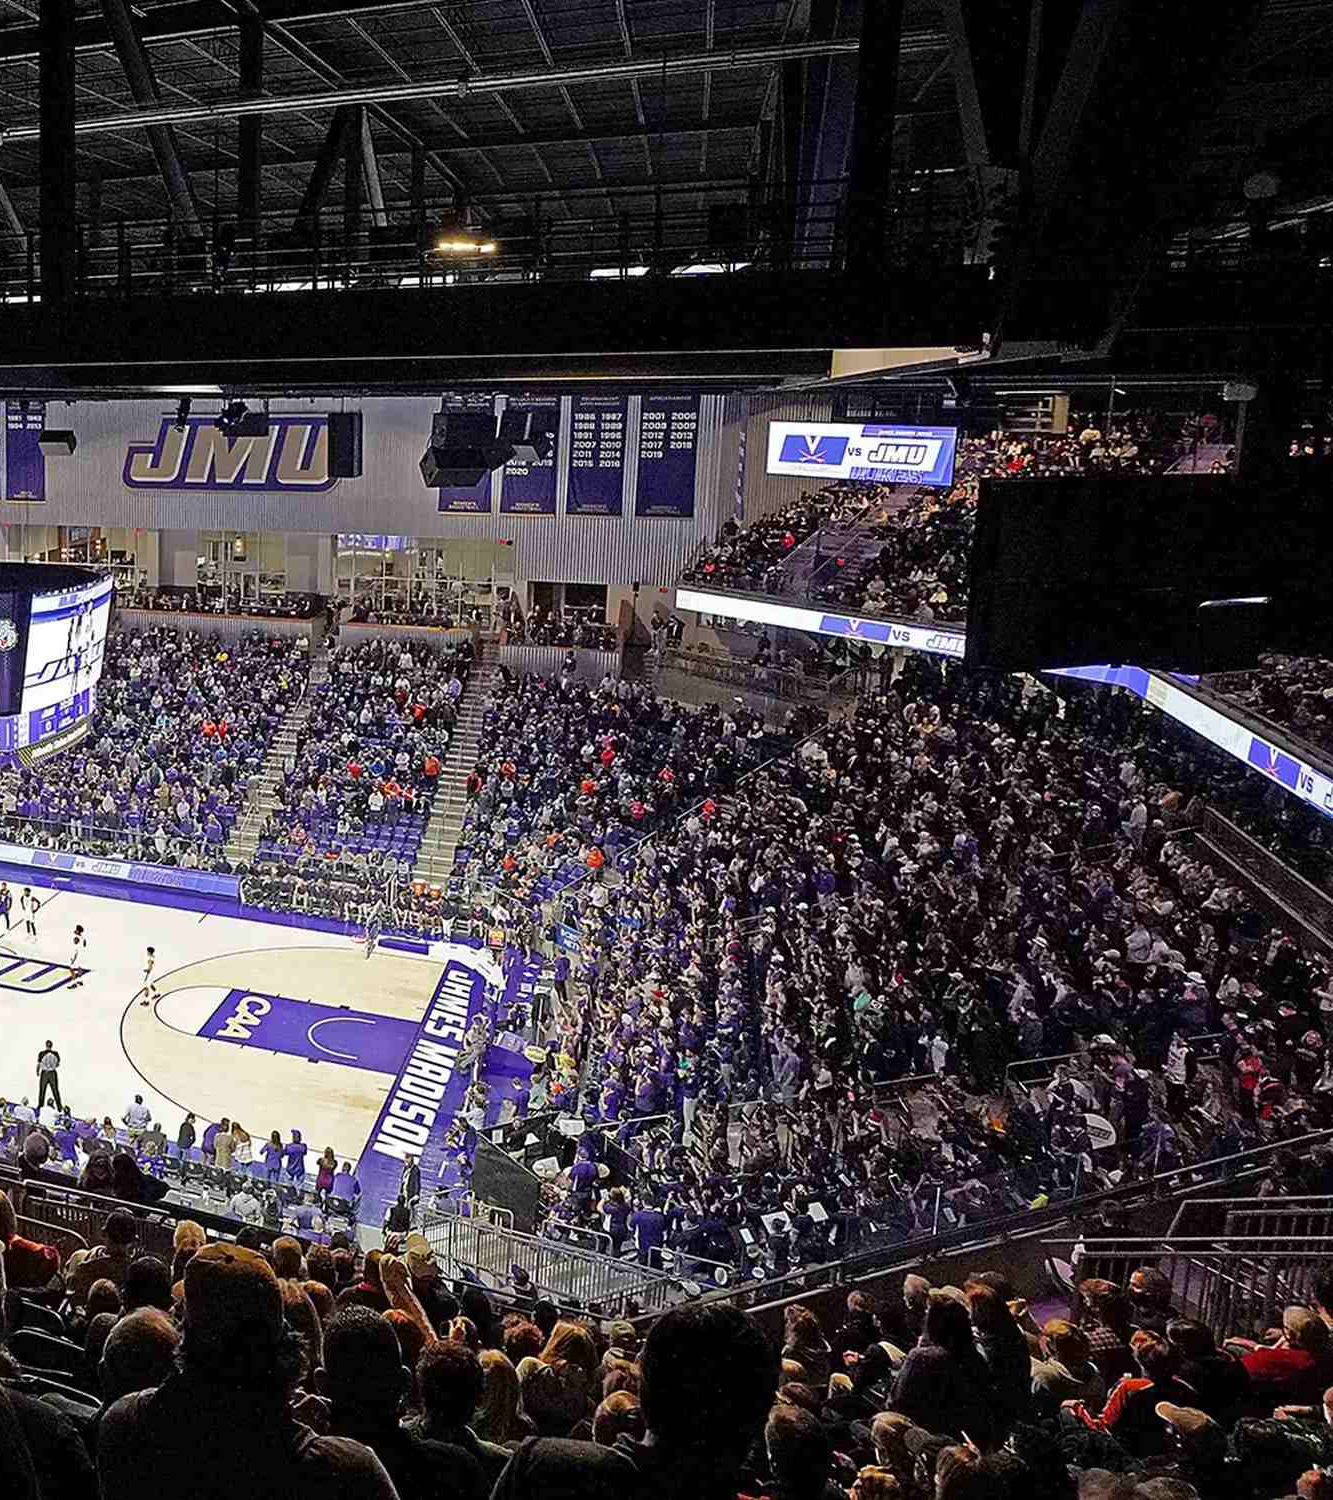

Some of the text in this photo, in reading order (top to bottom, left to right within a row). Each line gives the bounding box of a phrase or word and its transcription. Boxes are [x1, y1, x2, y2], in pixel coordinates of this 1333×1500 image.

[642, 412, 665, 420] 2001
[124, 416, 335, 491] JMU
[573, 441, 596, 449] 2007
[641, 440, 663, 449] 2017
[848, 447, 862, 457] VS
[867, 443, 928, 465] JMU
[505, 467, 529, 476] 2020
[892, 629, 911, 642] VS
[1300, 771, 1315, 794] VS
[423, 968, 475, 1042] JAMES
[216, 995, 271, 1039] CAA
[372, 1039, 459, 1164] MADISON
